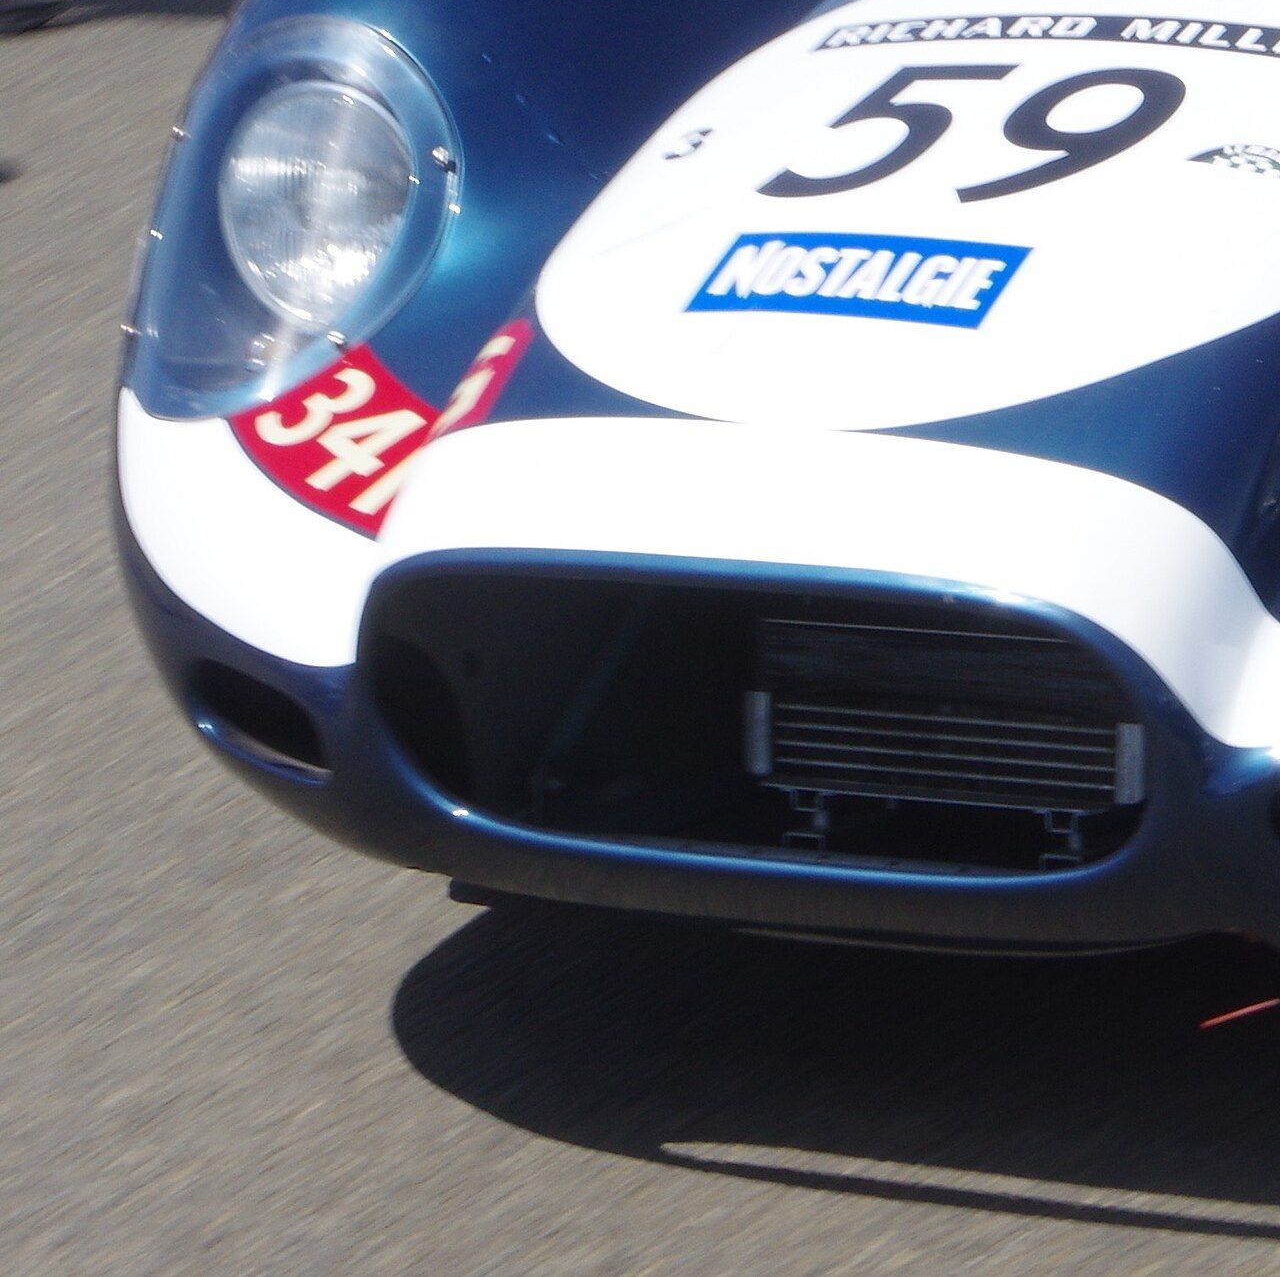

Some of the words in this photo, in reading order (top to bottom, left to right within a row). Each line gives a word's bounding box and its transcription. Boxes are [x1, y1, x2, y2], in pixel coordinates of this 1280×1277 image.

[824, 15, 1098, 49] RICHARD
[756, 63, 1186, 204] 59
[705, 239, 1007, 311] NOSTALGIE
